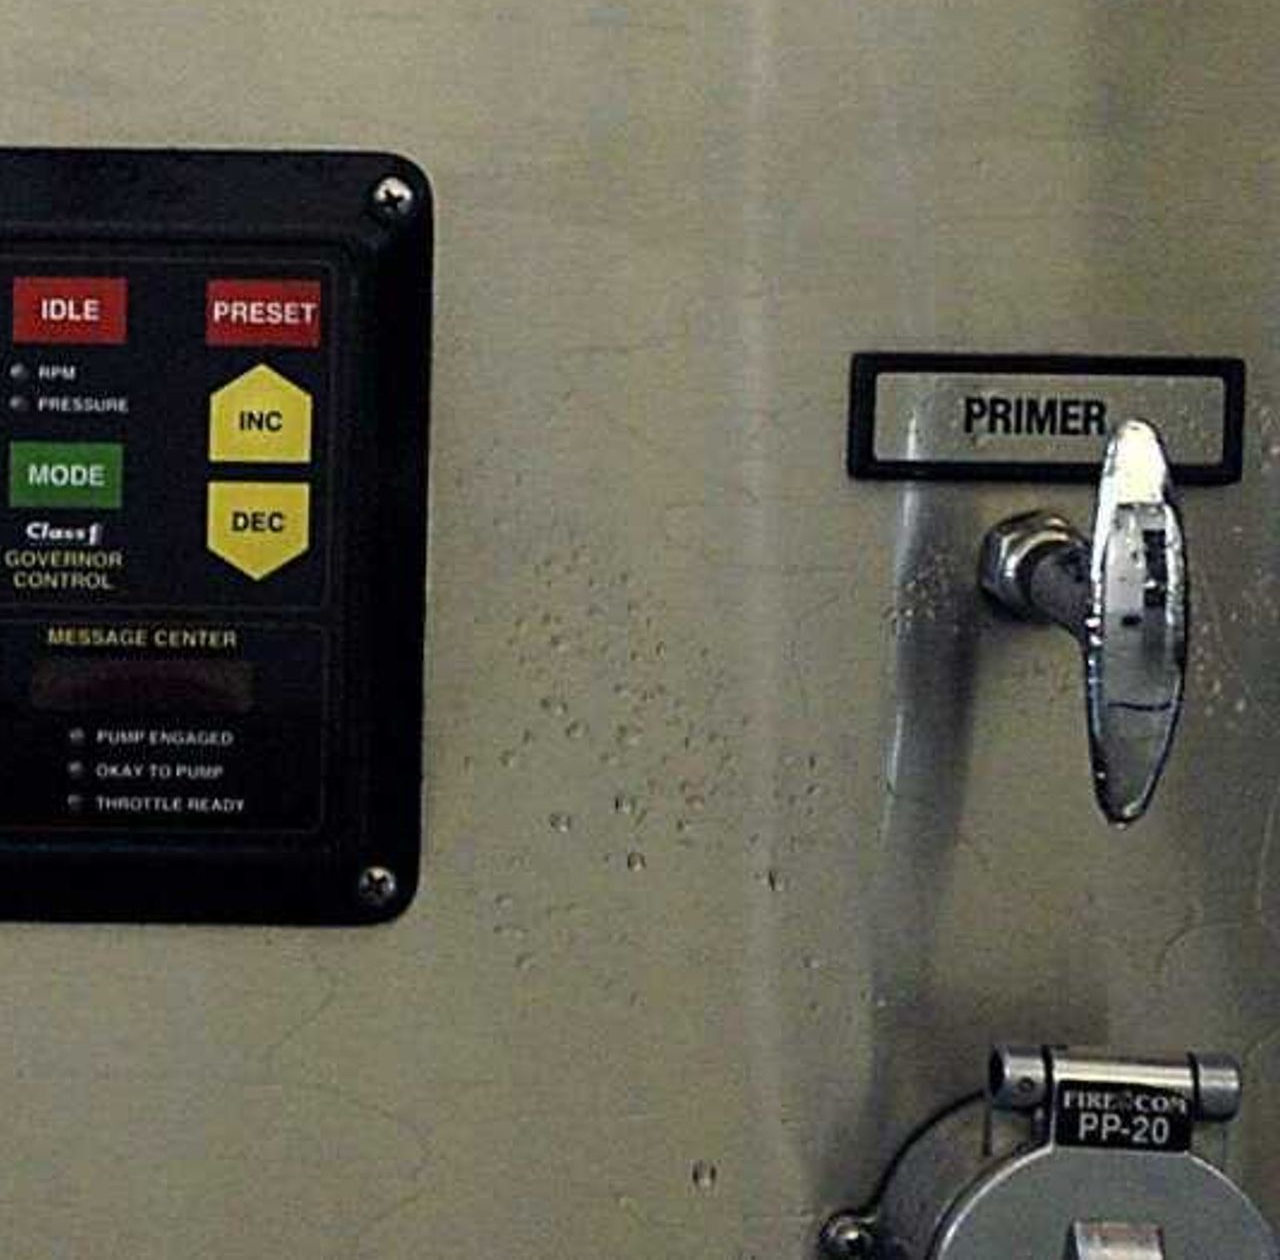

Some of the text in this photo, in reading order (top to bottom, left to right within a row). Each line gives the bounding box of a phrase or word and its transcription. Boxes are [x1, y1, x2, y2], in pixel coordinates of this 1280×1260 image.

[41, 300, 100, 320] IDLE
[214, 303, 317, 323] PRESET
[39, 366, 76, 380] RPM
[38, 398, 128, 413] PRESSURE
[240, 412, 283, 431] INC
[964, 397, 1106, 436] PRIMER
[28, 464, 105, 486] MODE
[232, 512, 284, 532] DEC
[4, 550, 122, 568] GOVERNOR
[13, 571, 114, 589] CONTROL
[49, 628, 237, 647] MESSAGE CENTER
[97, 729, 234, 746] PUMP ENGAGED
[96, 763, 224, 778] OKAY TO PUMP
[96, 796, 244, 812] THROTTLE READY
[1079, 1112, 1169, 1144] PP-20
